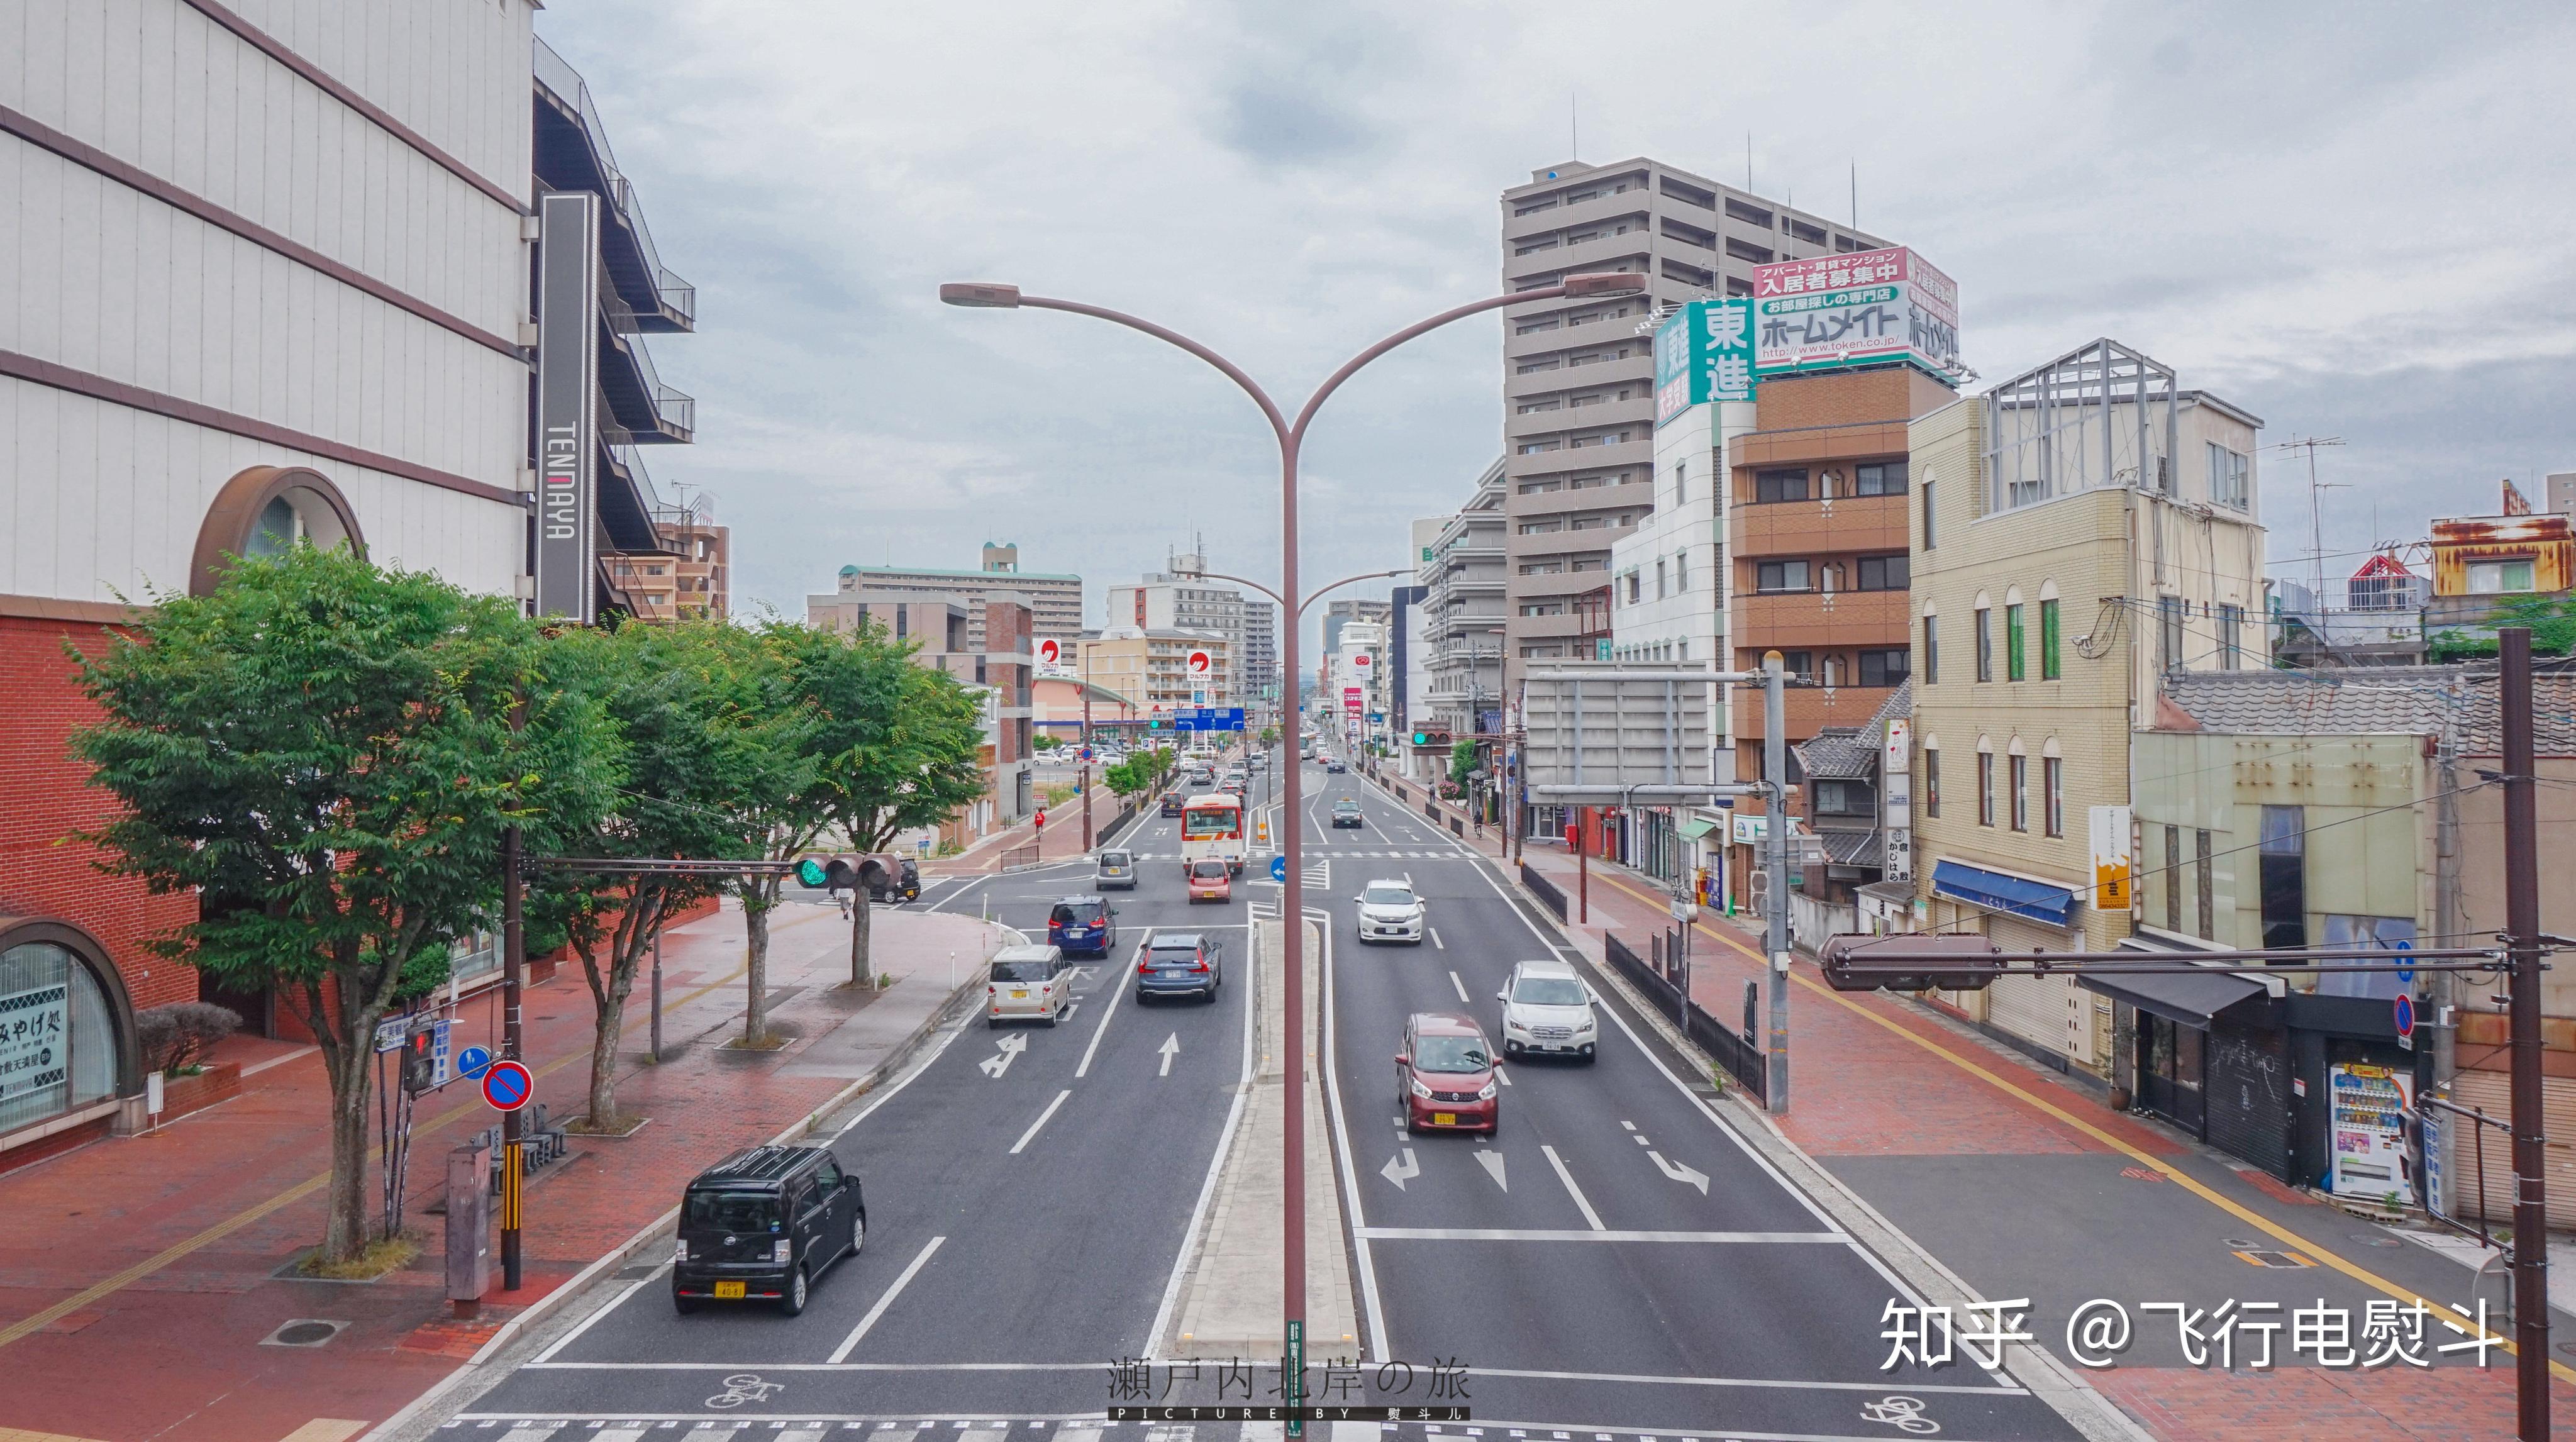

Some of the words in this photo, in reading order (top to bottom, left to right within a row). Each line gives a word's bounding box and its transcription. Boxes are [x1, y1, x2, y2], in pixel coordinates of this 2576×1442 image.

[1761, 263, 1898, 296] 入居者募集中
[1762, 253, 1897, 278] アパート・賃貸マンション
[1768, 288, 1890, 313] お部屋探しの専門店
[1916, 269, 1951, 307] 入居者募集中
[1762, 305, 1899, 347] ホームメイト
[1668, 315, 1689, 378] 東進
[1705, 305, 1748, 401] 東進
[1763, 335, 1899, 357] http://www.token.co.jp/
[1660, 372, 1689, 420] 大学受験
[1889, 842, 1898, 881] かじはら
